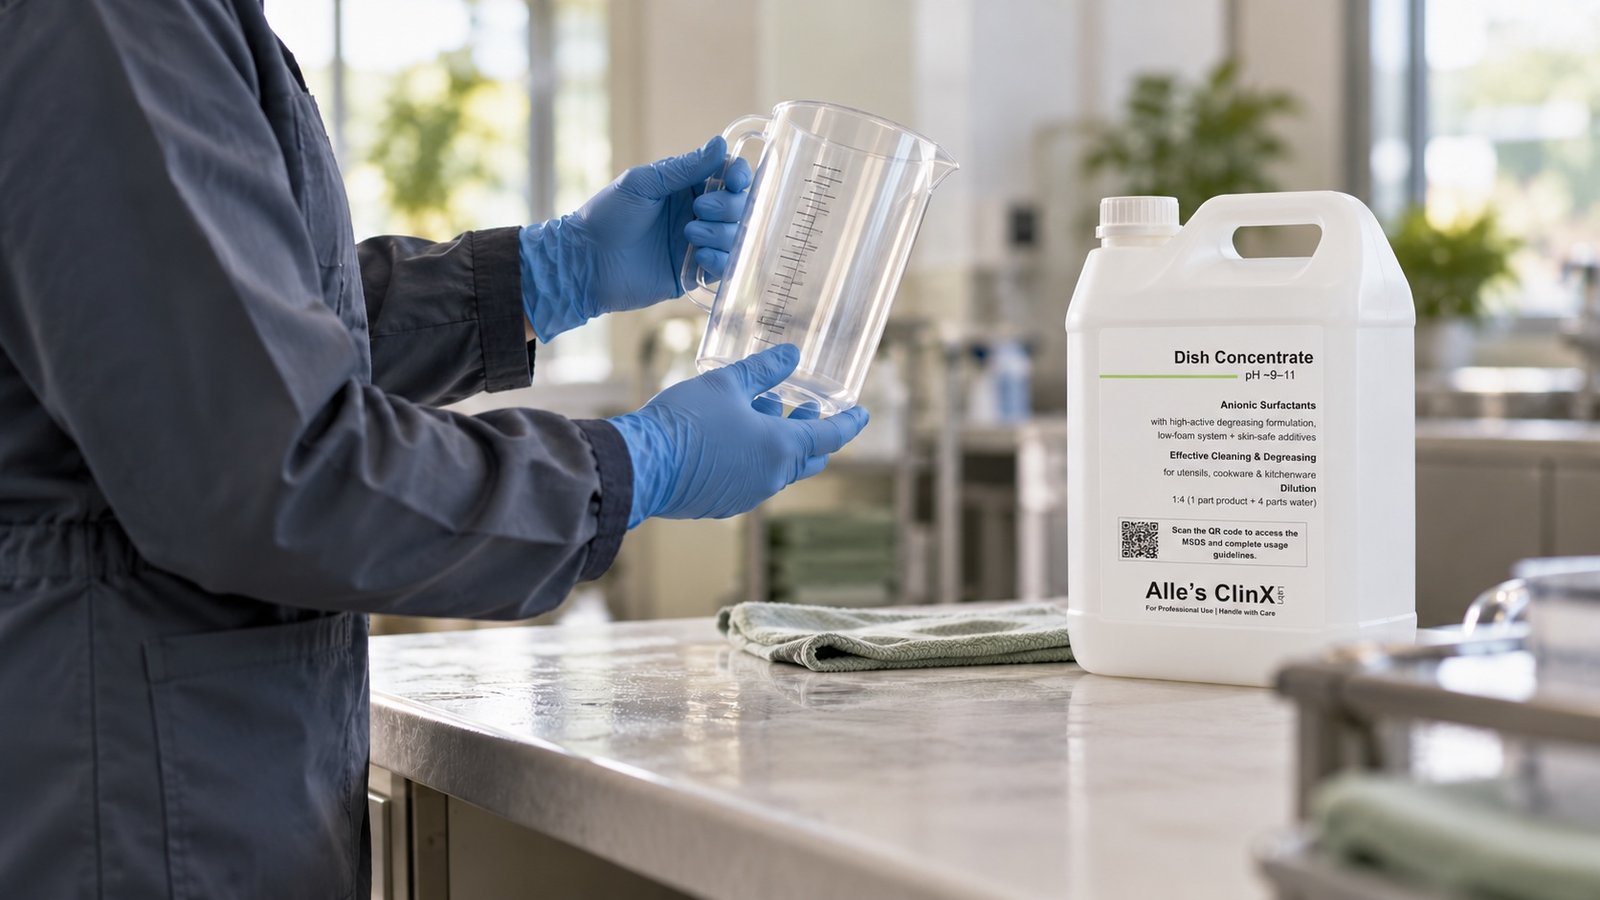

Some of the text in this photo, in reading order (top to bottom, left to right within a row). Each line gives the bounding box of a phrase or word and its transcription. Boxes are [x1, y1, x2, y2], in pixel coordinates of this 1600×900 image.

[1174, 349, 1314, 365] Dish Concentrate
[1245, 369, 1261, 383] pH
[1220, 400, 1317, 410] Anionic Surfactants
[1150, 417, 1317, 429] with high-active degreasing formulation,
[1157, 431, 1196, 440] low-foam
[1197, 432, 1228, 442] system
[1237, 431, 1276, 441] skin-safe
[1277, 432, 1317, 442] additives
[1169, 450, 1317, 464] Effective Cleaning & Degreasing
[1163, 467, 1317, 480] for utensils, cookware & kitchenware
[1280, 483, 1317, 493] Dilution
[1172, 495, 1185, 504] 1:4
[1186, 495, 1195, 506] (1
[1197, 496, 1215, 506] part
[1215, 496, 1248, 507] product
[1257, 497, 1264, 506] 4
[1265, 498, 1288, 508] parts
[1289, 498, 1317, 509] water)
[1171, 525, 1299, 538] Scan the QR code to access the
[1181, 537, 1289, 551] MSDS and complete usage
[1212, 550, 1257, 560] guidelines.
[1214, 583, 1276, 605] ClinX
[1145, 604, 1158, 612] For
[1157, 605, 1200, 614] Professional
[1218, 607, 1243, 616] Handle
[1259, 609, 1277, 617] Care
